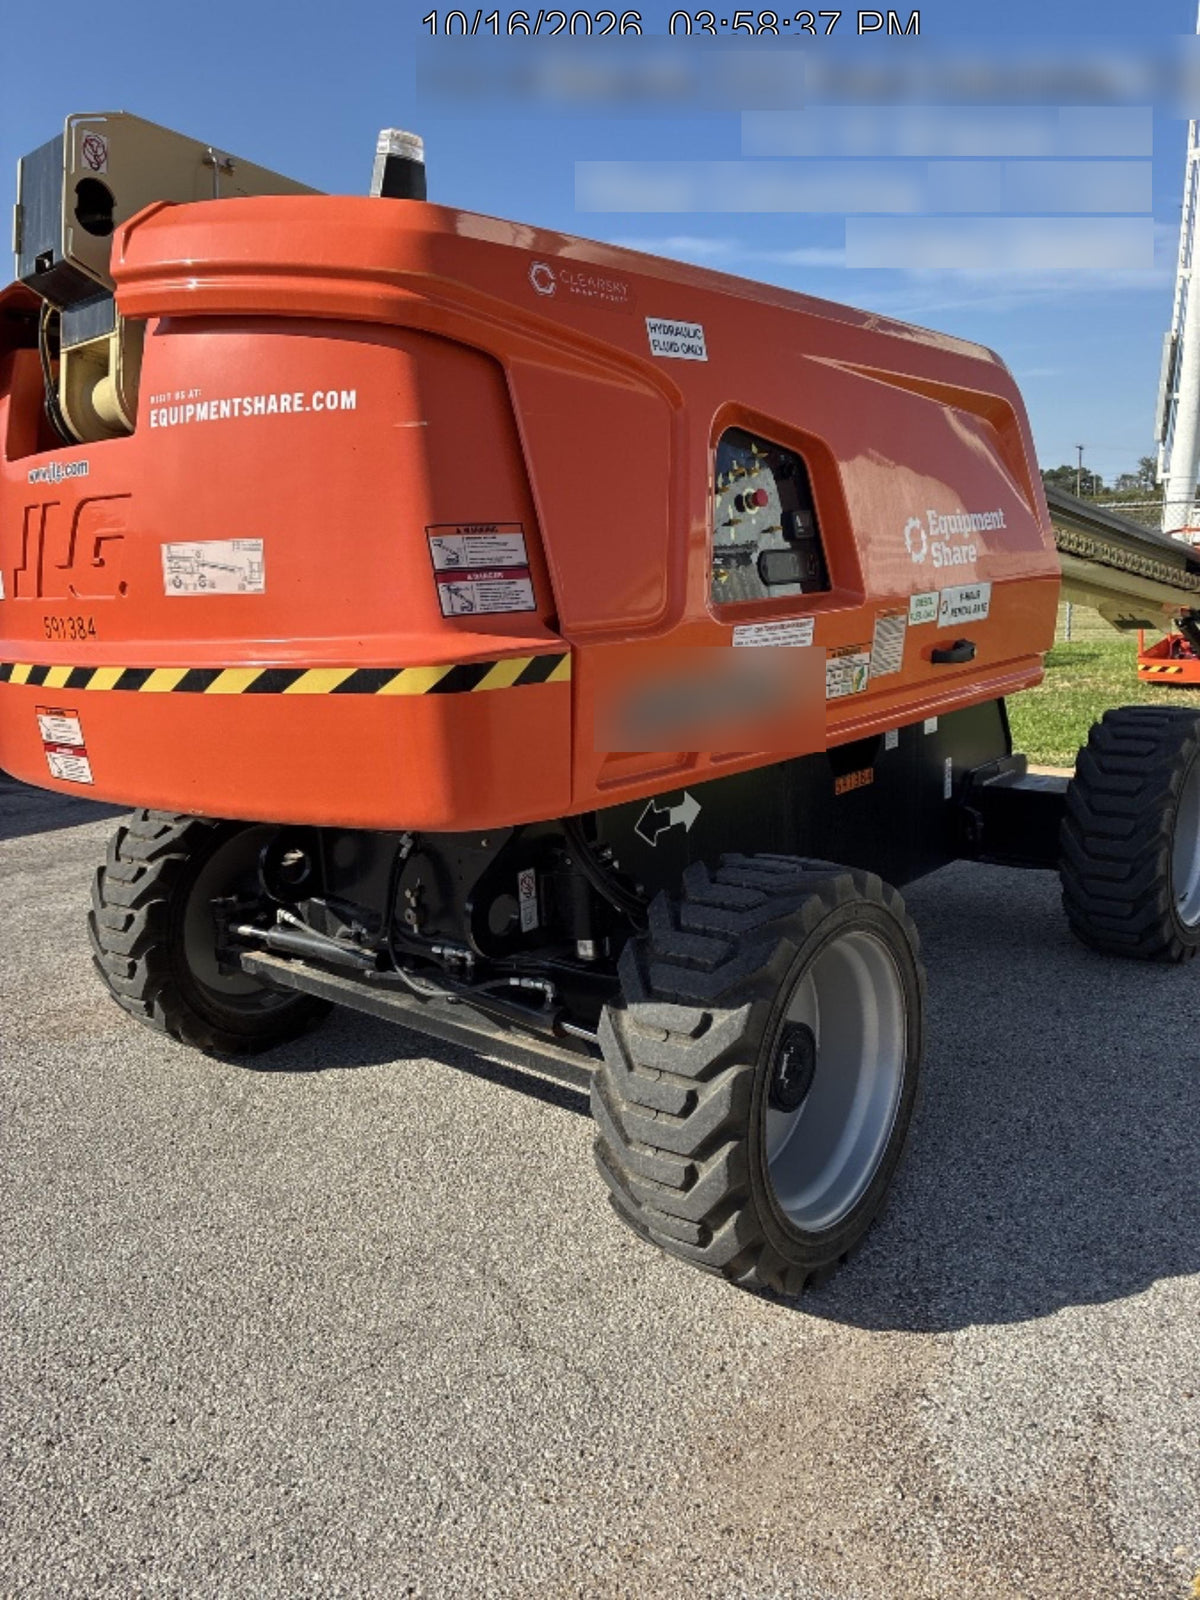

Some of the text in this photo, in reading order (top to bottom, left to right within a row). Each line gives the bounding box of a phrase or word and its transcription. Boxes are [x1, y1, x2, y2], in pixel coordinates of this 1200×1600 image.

[559, 269, 629, 295] CLEARSKY
[648, 321, 702, 341] HYDRAULIC
[652, 338, 704, 356] FLUID ONLY
[150, 389, 357, 428] EQUIPMENTSHARE.COM
[28, 460, 89, 484] www.jlg.com
[926, 507, 1007, 541] Equipment
[931, 541, 977, 568] Share
[43, 616, 97, 640] 591384
